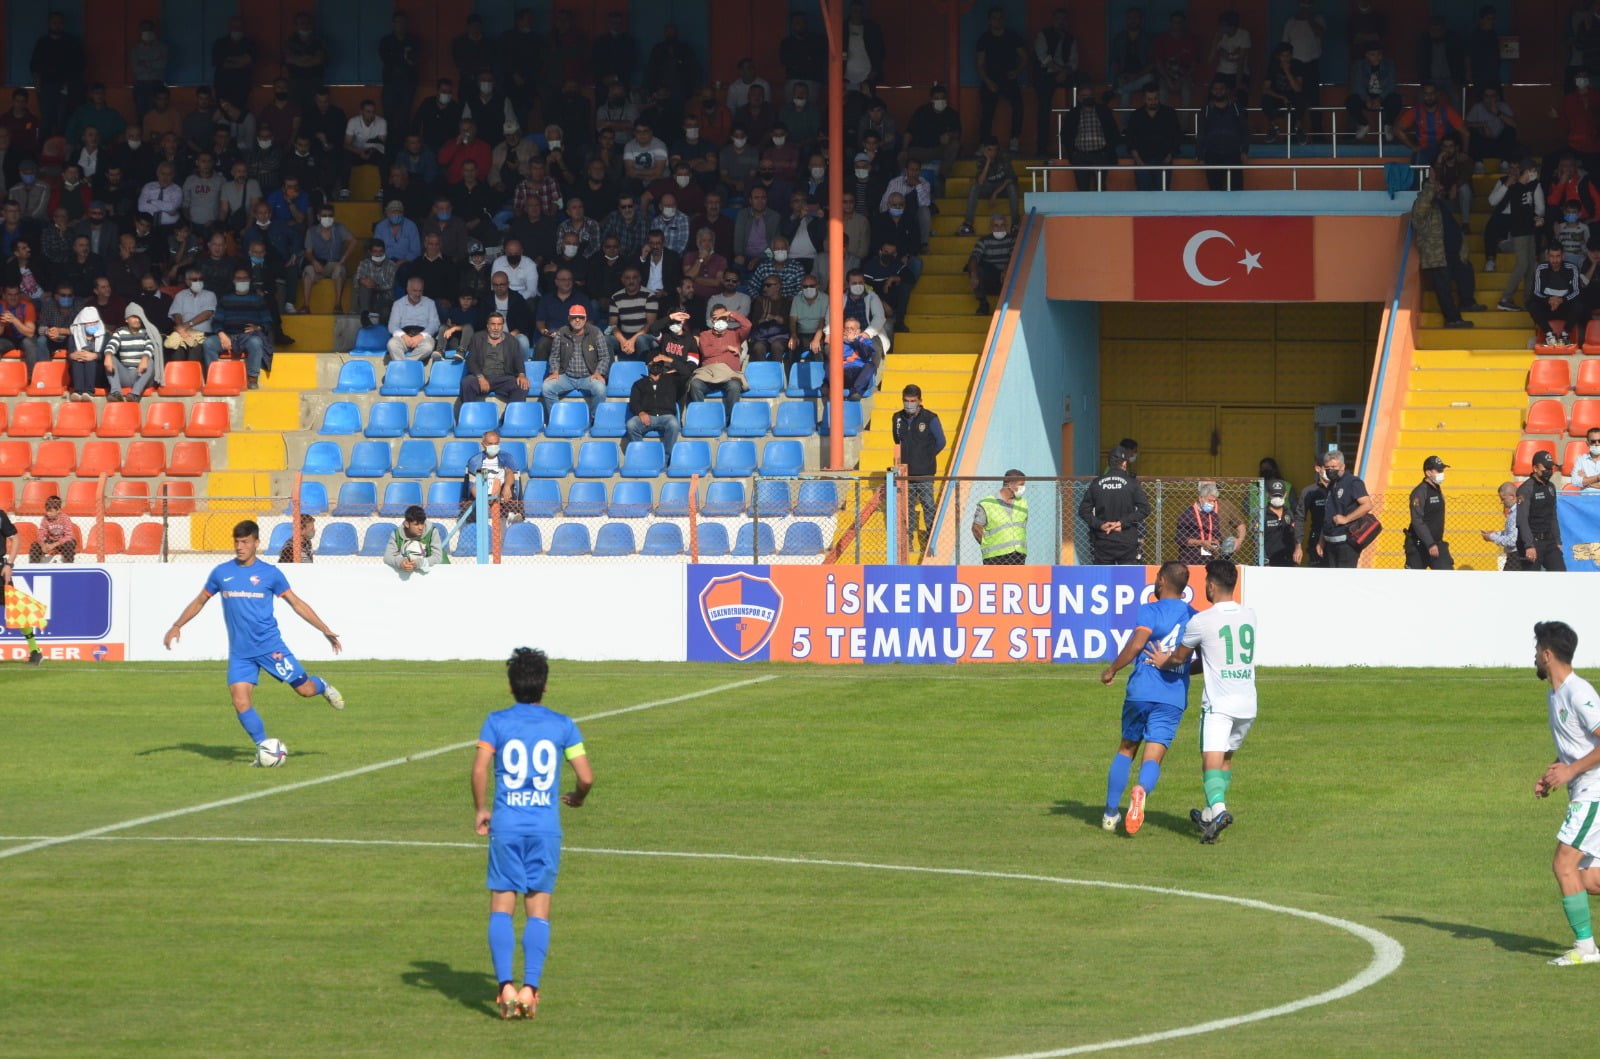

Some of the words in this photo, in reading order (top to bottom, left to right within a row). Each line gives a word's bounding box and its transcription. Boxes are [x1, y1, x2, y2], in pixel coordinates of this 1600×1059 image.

[791, 626, 812, 659] 5
[825, 626, 996, 659] TEMMUZ
[1008, 626, 1200, 660] STADY
[1160, 623, 1181, 653] 4
[1218, 623, 1255, 665] 19
[275, 658, 295, 676] 64
[502, 738, 558, 791] 99
